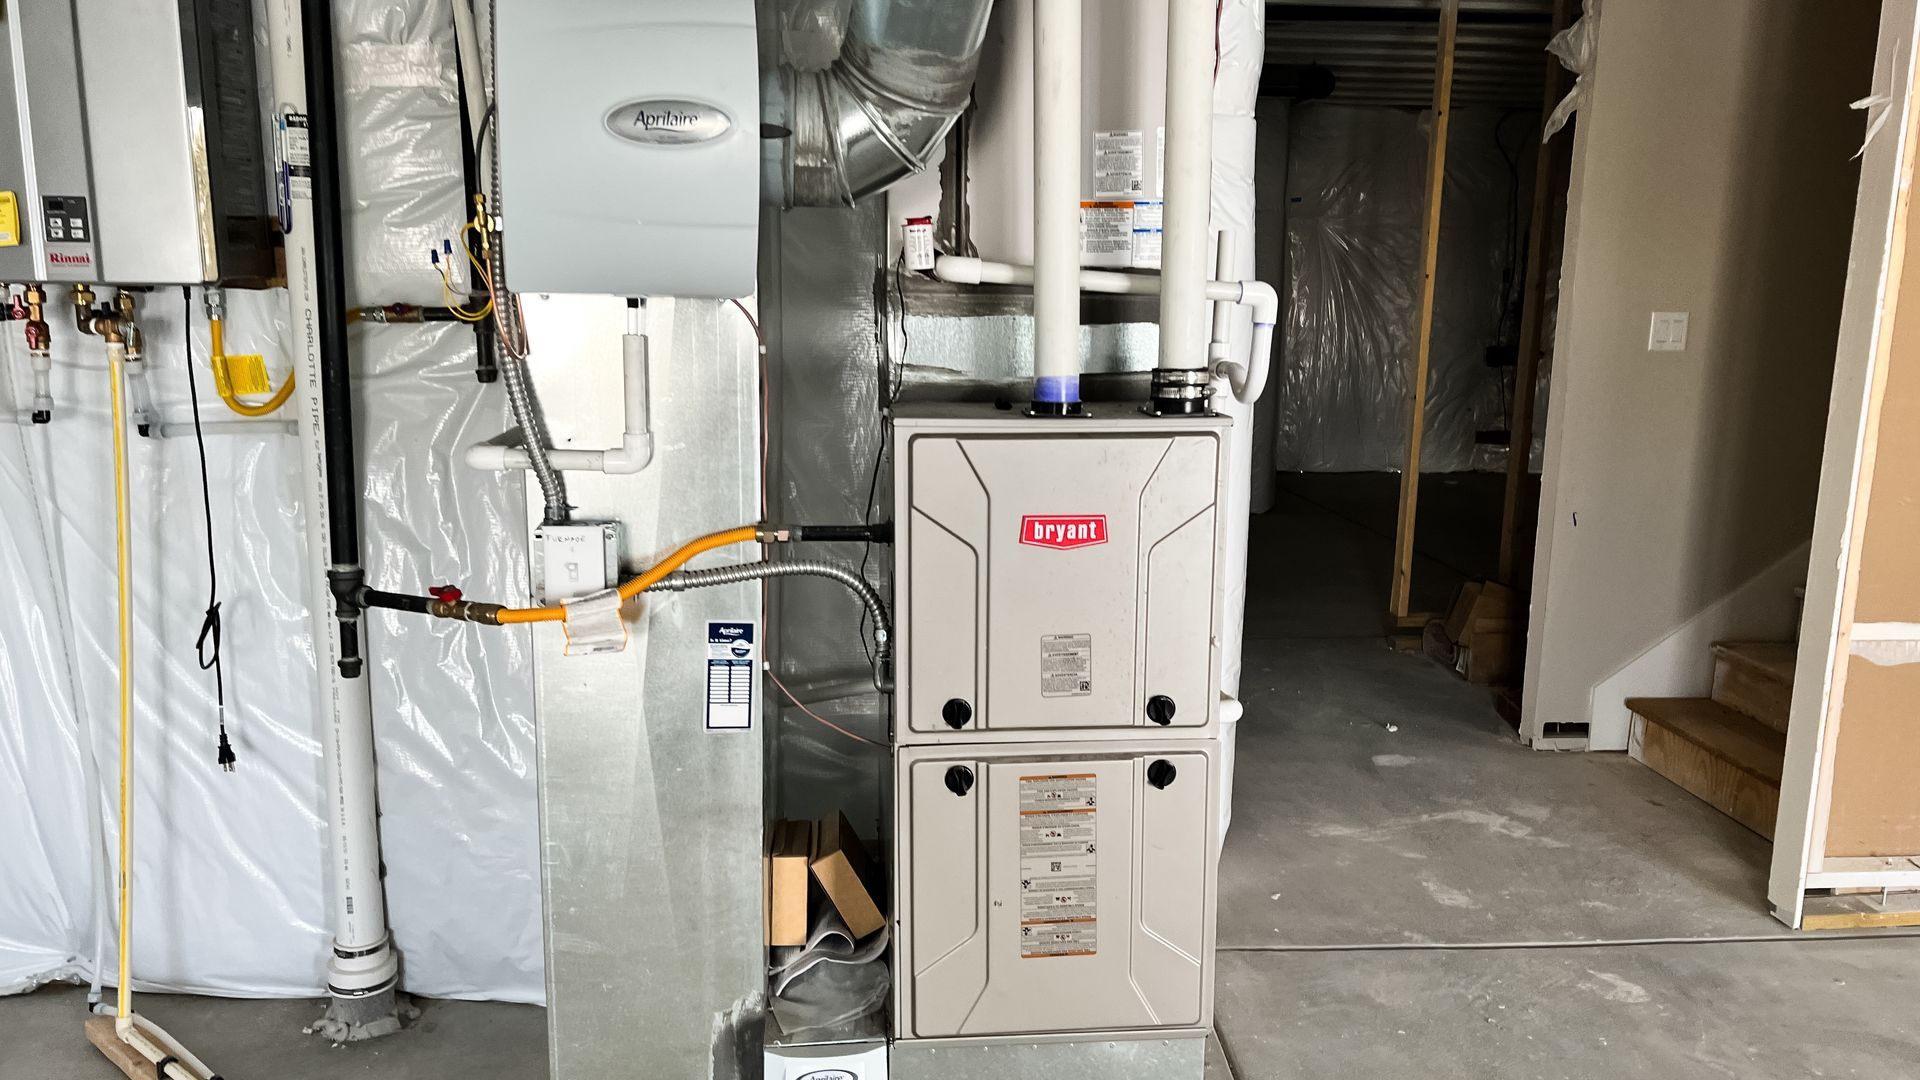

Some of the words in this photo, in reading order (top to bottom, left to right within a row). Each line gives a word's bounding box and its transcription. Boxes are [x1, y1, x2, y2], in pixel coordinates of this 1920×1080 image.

[633, 109, 698, 131] Aprilaire
[49, 252, 91, 264] Rinnai
[304, 308, 317, 389] CHARLOTTE
[1034, 521, 1097, 543] bryant
